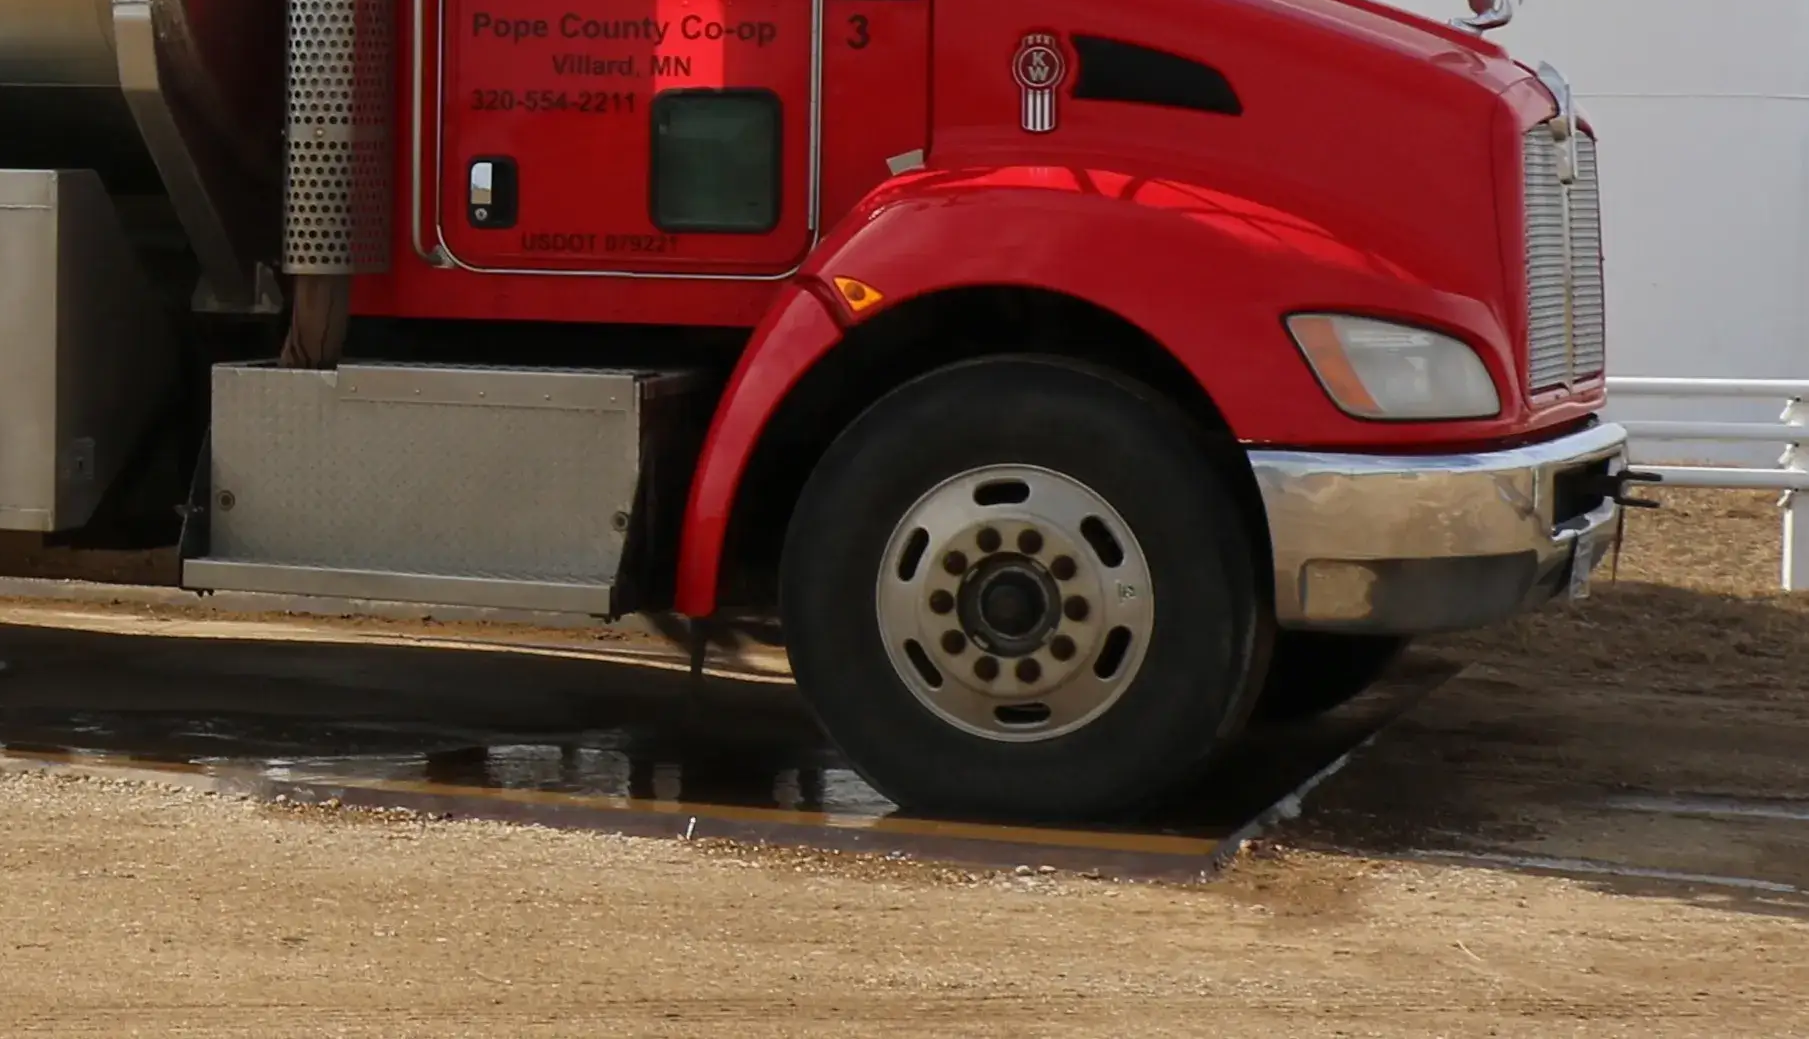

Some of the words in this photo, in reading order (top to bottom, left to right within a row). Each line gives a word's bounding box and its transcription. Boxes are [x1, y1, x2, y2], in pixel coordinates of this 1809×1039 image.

[472, 12, 548, 44] Pope
[559, 13, 670, 46] County
[680, 14, 777, 47] Co-op
[845, 14, 871, 49] 3
[552, 55, 641, 79] Villard,
[650, 56, 692, 77] MN
[470, 88, 636, 113] 320-554-2211
[521, 232, 596, 253] USDOT
